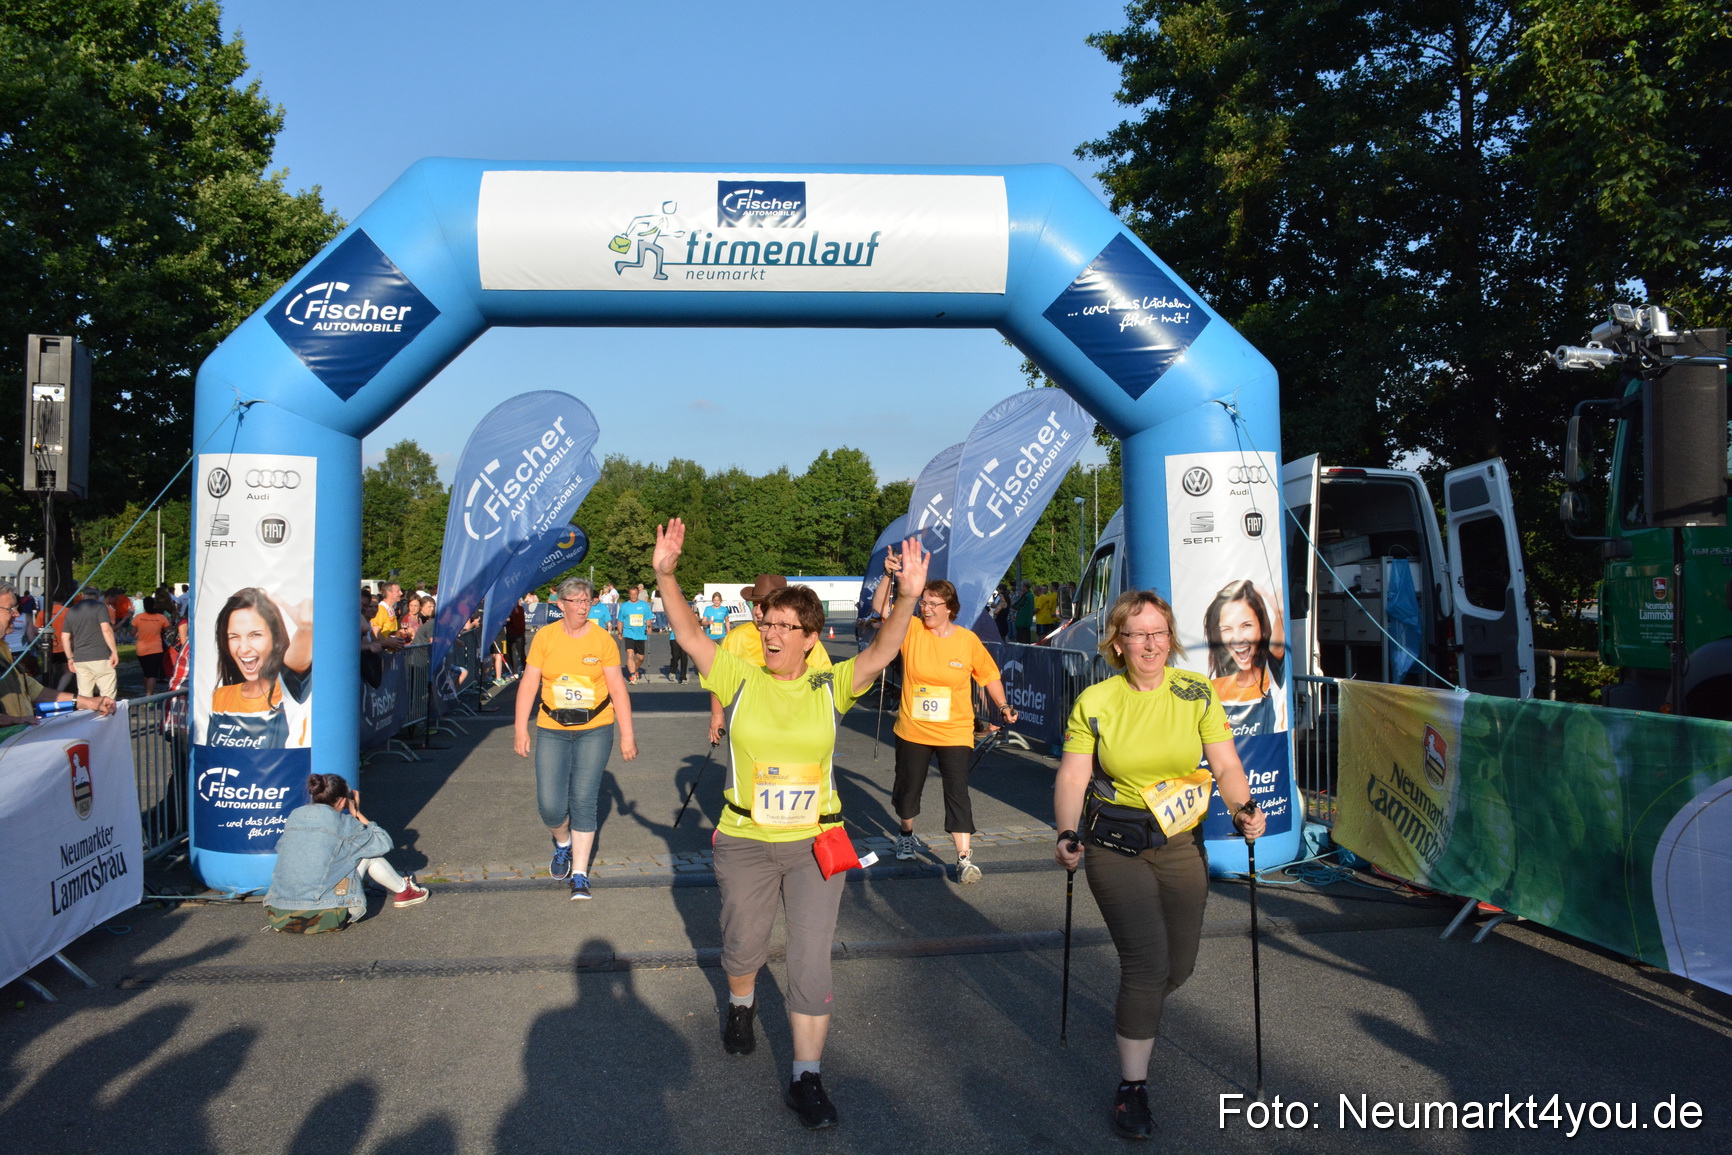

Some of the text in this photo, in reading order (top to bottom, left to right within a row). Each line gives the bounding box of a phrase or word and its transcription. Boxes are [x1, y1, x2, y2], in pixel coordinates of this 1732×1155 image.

[735, 197, 802, 211] Fischer
[686, 230, 882, 266] firmenlauf
[686, 267, 766, 281] neumarkt
[304, 299, 412, 321] Fischer
[1083, 299, 1110, 316] und
[1115, 298, 1140, 310] das
[312, 322, 403, 333] AUTOMOBILE
[483, 415, 566, 523] Fischer
[985, 410, 1063, 520] Fischer
[1013, 429, 1072, 517] AUTOMOBILE
[509, 436, 576, 522] AUTOMOBILE
[536, 474, 583, 541] AUTOMOBILE
[264, 523, 284, 538] FIAT
[1247, 517, 1262, 531] FIAT
[1183, 536, 1223, 545] SEAT
[565, 688, 582, 701] 56
[1005, 681, 1047, 711] Fischer
[922, 699, 938, 712] 69
[216, 733, 266, 749] Fischer
[208, 781, 290, 800] Fischer
[214, 800, 282, 810] AUTOMOBILE
[759, 789, 816, 811] 1177
[245, 816, 263, 827] das
[263, 814, 287, 826] Läche
[60, 825, 114, 870] Neumarkter
